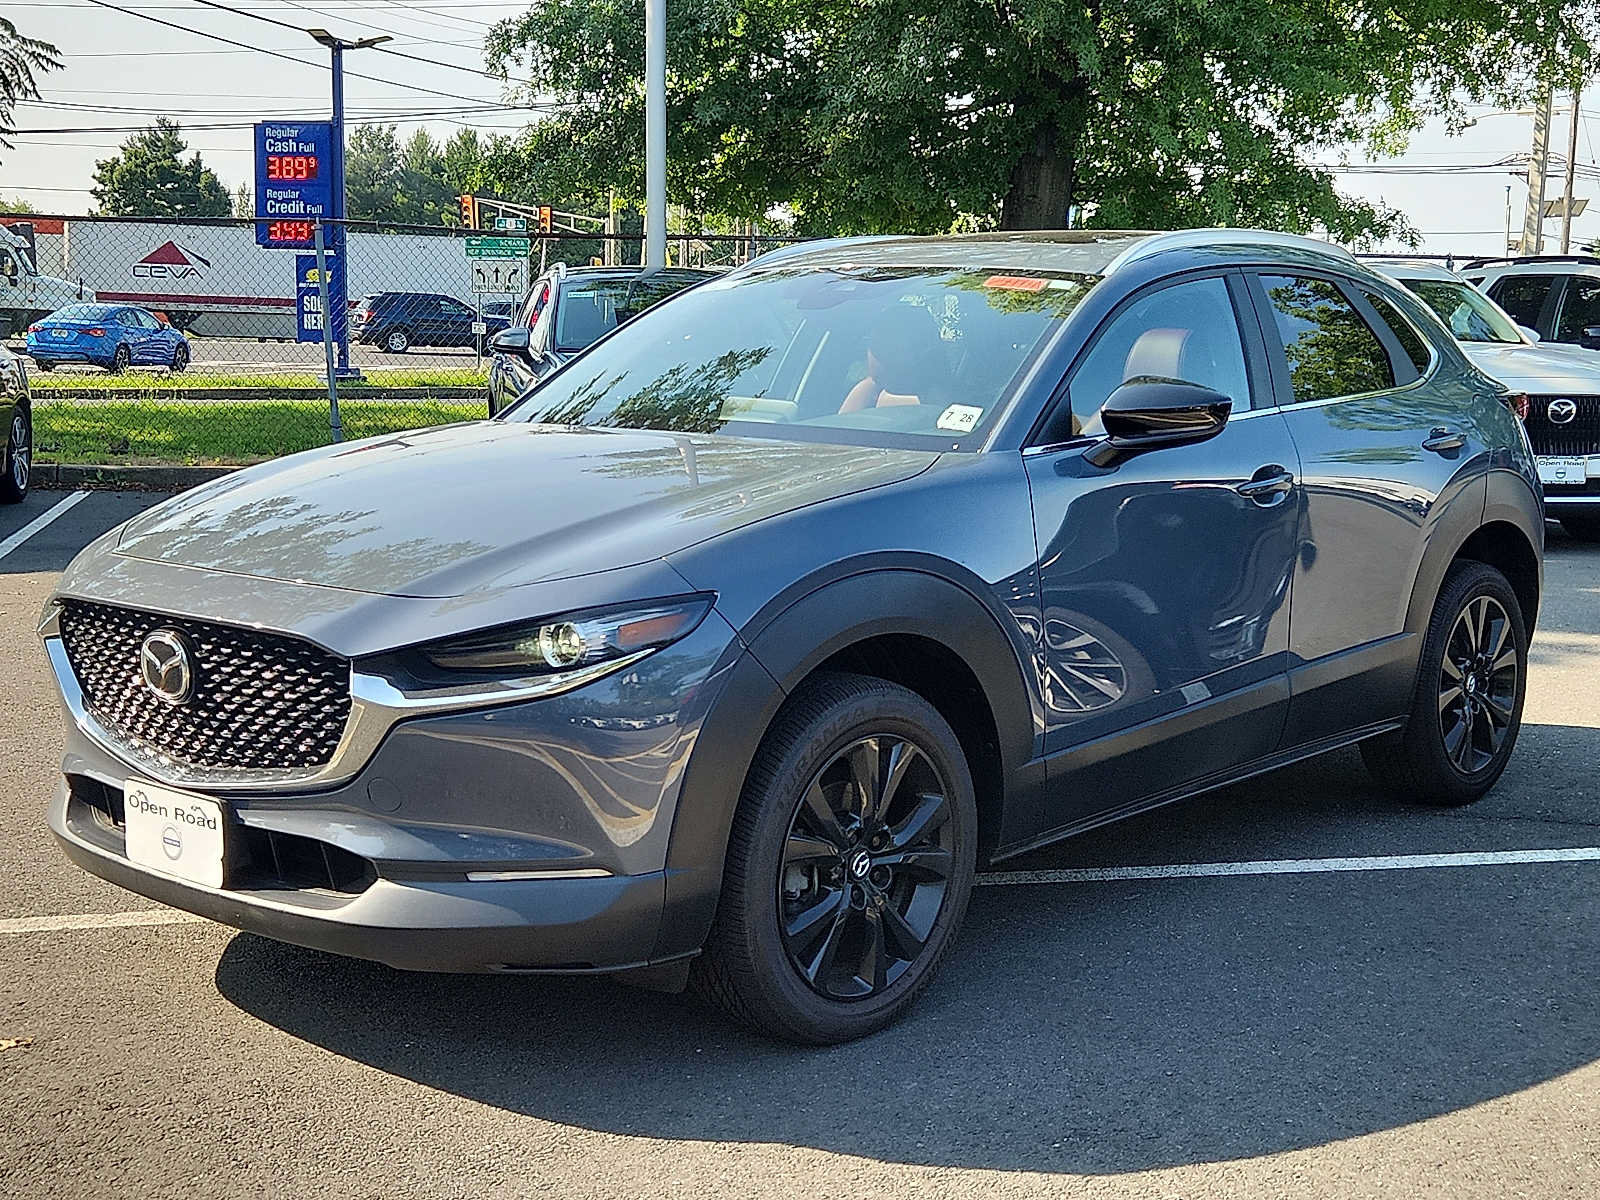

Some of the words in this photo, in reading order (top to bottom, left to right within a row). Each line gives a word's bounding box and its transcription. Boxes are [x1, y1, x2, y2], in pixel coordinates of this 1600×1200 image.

[265, 127, 299, 138] Regular
[265, 139, 297, 152] Cash
[299, 143, 315, 152] Full
[266, 189, 300, 200] Regular
[266, 200, 305, 214] Credit
[306, 205, 323, 214] Full
[132, 265, 204, 280] CEVA
[303, 296, 323, 312] SOL
[945, 411, 955, 421] 7
[128, 794, 168, 817] Open
[174, 807, 217, 831] Road
